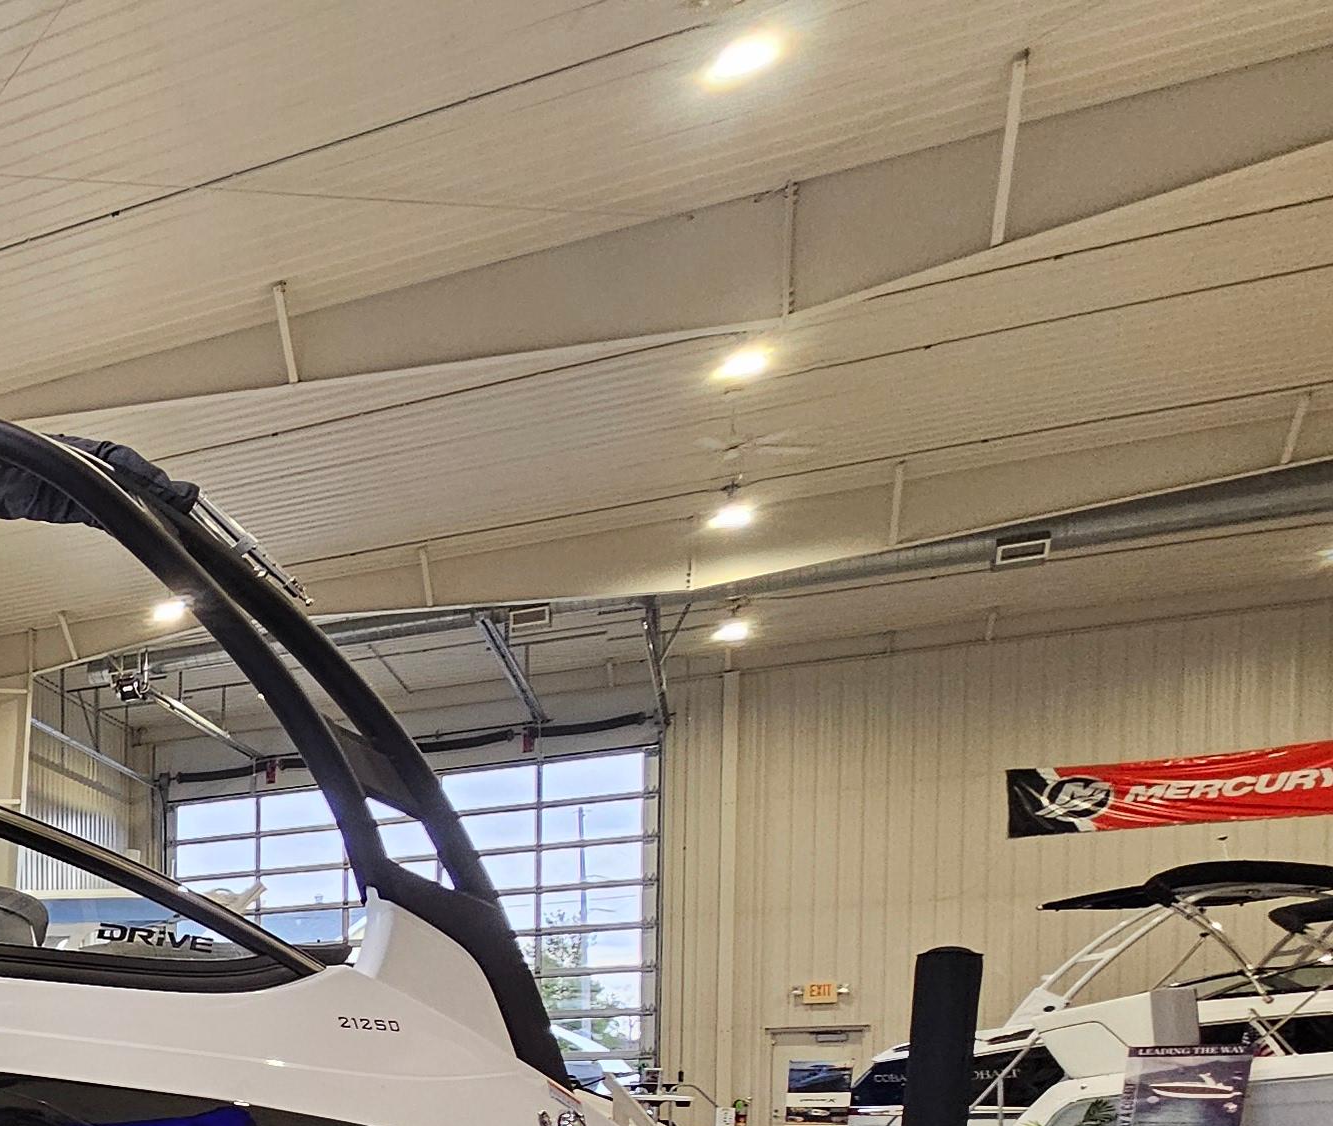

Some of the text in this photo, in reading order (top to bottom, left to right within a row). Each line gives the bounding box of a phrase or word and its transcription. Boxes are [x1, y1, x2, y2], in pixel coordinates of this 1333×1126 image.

[809, 984, 832, 998] EXIT
[337, 1016, 400, 1032] 212SD
[1138, 1045, 1247, 1056] LEADING THE WAY
